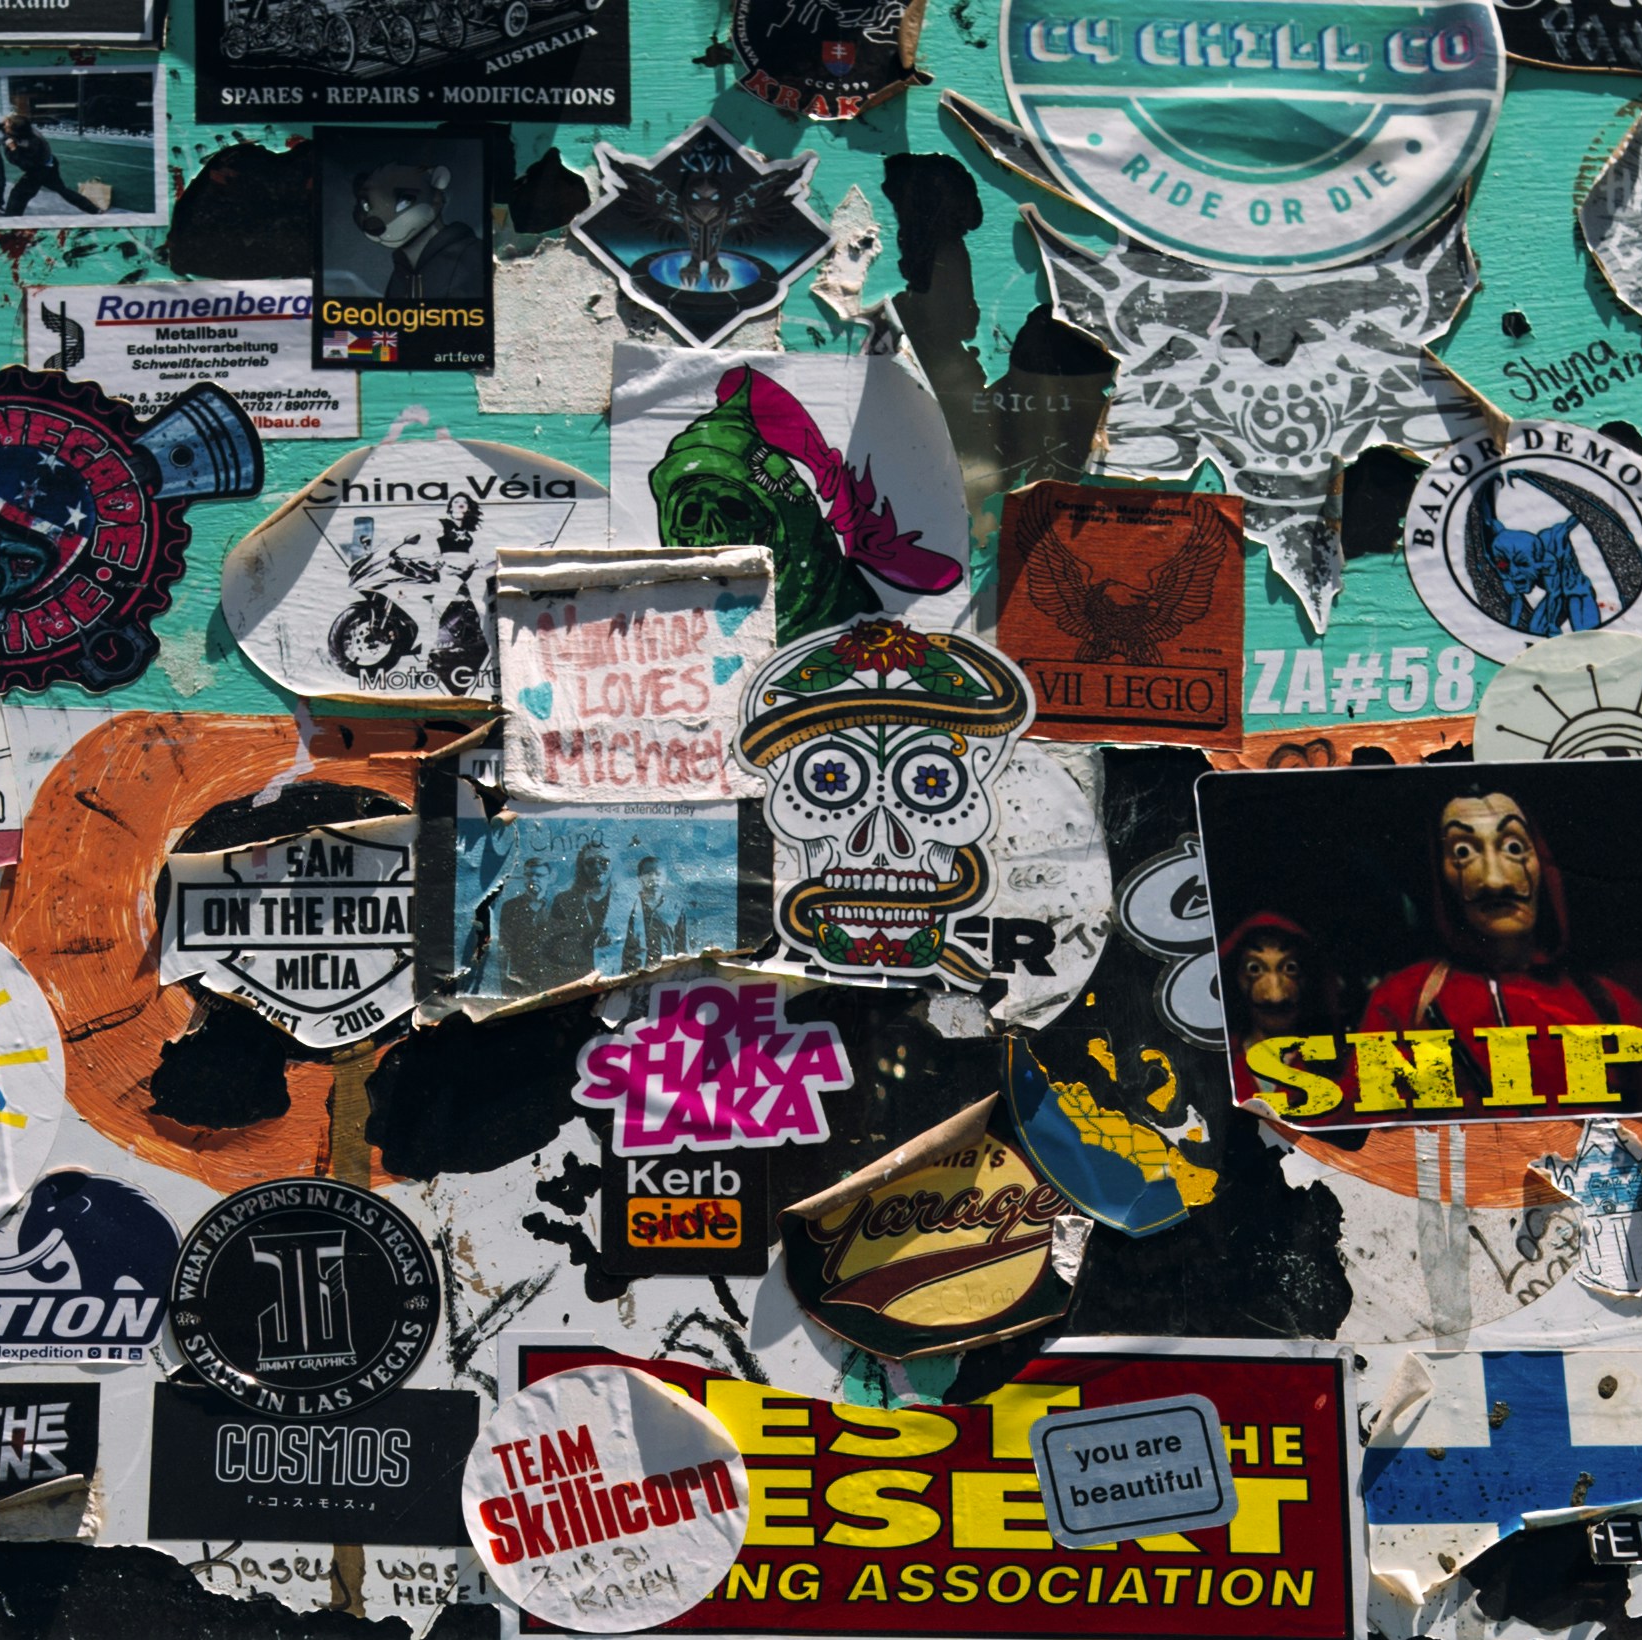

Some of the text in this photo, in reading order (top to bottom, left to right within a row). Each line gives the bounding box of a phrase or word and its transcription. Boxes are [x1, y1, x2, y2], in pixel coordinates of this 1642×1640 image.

[221, 87, 616, 106] SPARES REPAIRS MODIFICATIONS
[98, 294, 311, 320] Ronnenberg
[323, 301, 485, 332] Geologisms
[126, 341, 278, 355] Edelstahlverarbeitung
[156, 326, 238, 341] Metallbau
[132, 355, 269, 371] Schweißfachbetrieb
[307, 473, 577, 503] China Véia
[1036, 668, 1215, 714] VII LEGIO
[1247, 648, 1477, 716] ZA#58
[287, 845, 354, 877] SAM
[204, 899, 324, 936] ON THE
[276, 955, 360, 992] MICIA
[333, 1002, 385, 1035] 2016
[644, 985, 775, 1045] JOE
[583, 1018, 845, 1102] SHAKA
[623, 1078, 829, 1148] LAKA
[626, 1160, 743, 1197] Kerb
[215, 1425, 411, 1486] COSMOS
[492, 1425, 600, 1490] TEAM
[1074, 1435, 1182, 1470] you are
[1069, 1467, 1203, 1507] beautiful
[480, 1458, 741, 1566] Skillicorn
[847, 1563, 1315, 1609] ASSOCIATION
